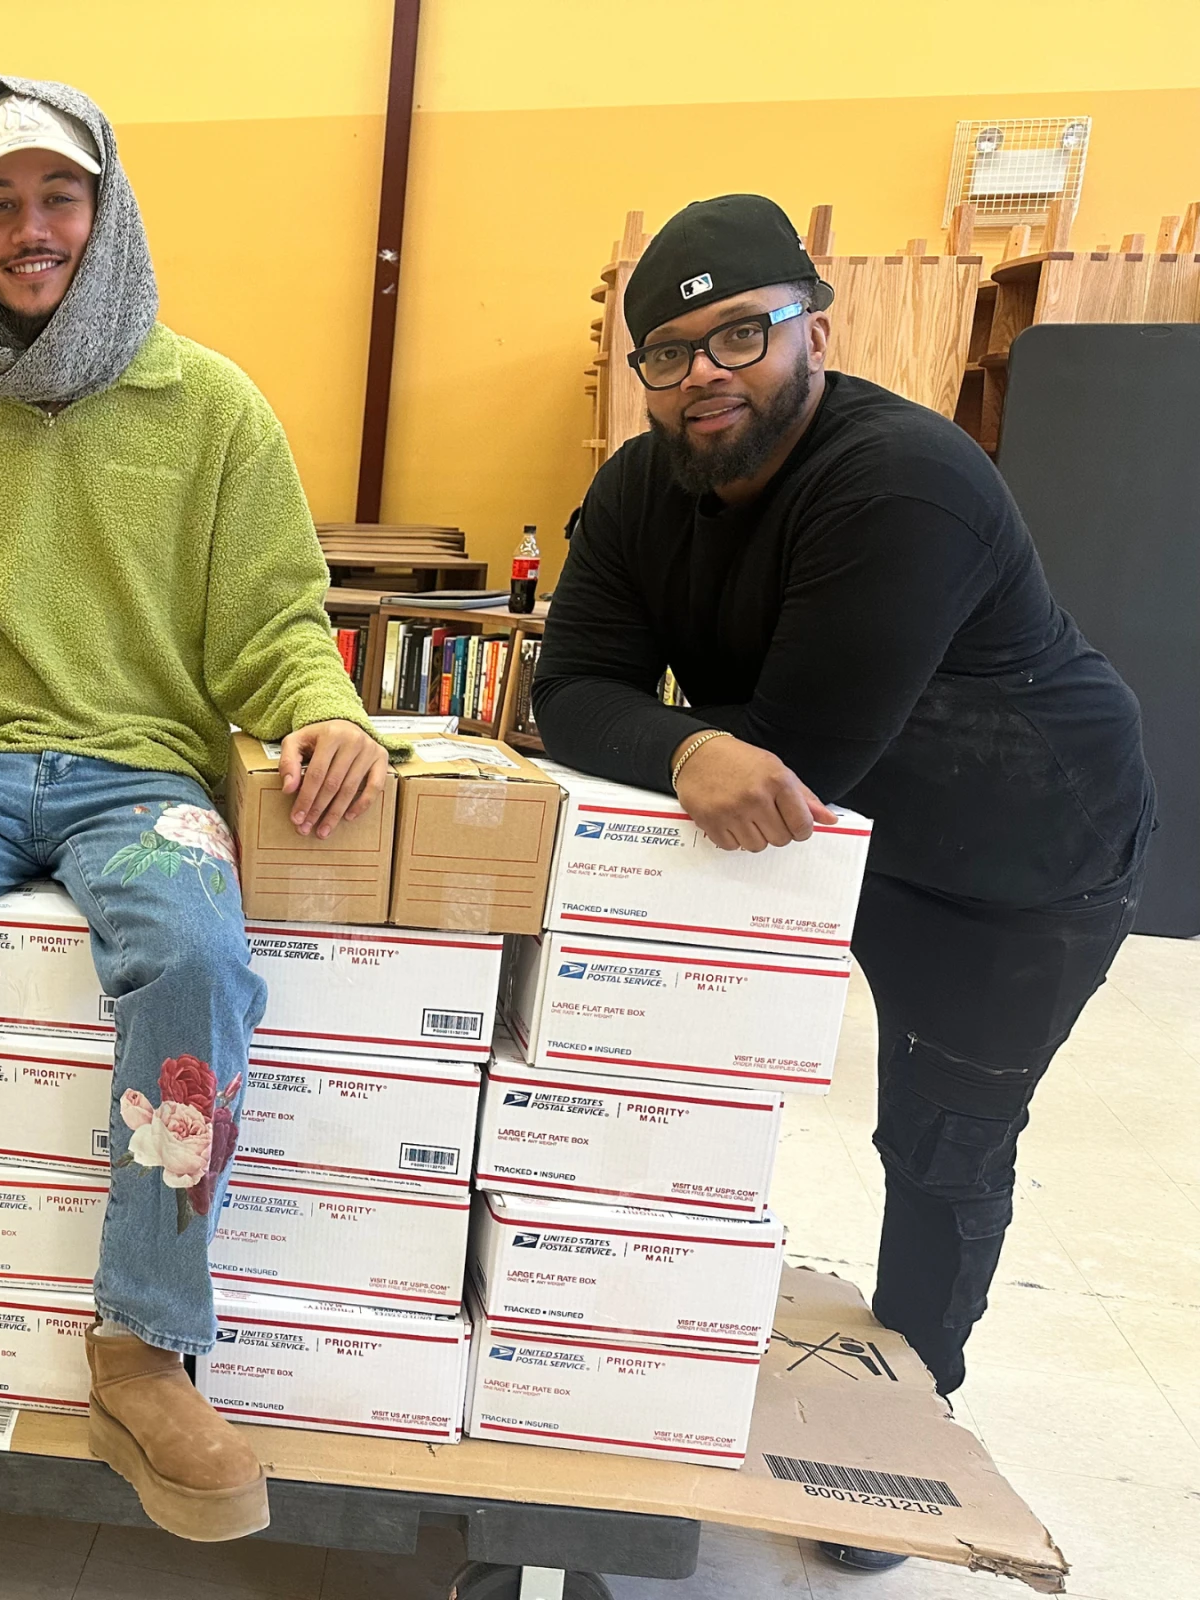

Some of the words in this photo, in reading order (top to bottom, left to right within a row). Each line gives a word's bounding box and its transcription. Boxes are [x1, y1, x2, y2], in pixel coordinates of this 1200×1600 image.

[608, 822, 645, 833] UNITED
[645, 826, 680, 836] STATES
[604, 832, 640, 843] POSTAL
[568, 861, 597, 871] LARGE
[598, 864, 618, 873] FLAT
[620, 867, 642, 875] RATE
[643, 869, 663, 877] BOX
[561, 902, 602, 913] TRACKED
[610, 907, 648, 918] INSURED
[253, 938, 287, 948] UNITED
[287, 941, 319, 951] STATES
[249, 948, 282, 957] POSTAL
[352, 957, 380, 965] MAIL
[590, 964, 627, 974] UNITED
[627, 967, 661, 977] STATES
[586, 973, 622, 983] POSTAL
[697, 983, 728, 992] MAIL
[552, 1001, 580, 1011] LARGE
[582, 1004, 602, 1013] FLAT
[603, 1006, 625, 1015] RATE
[626, 1009, 646, 1017] BOX
[547, 1040, 587, 1051] TRACKED
[594, 1045, 632, 1056] INSURED
[34, 1078, 60, 1087] MAIL
[341, 1090, 368, 1099] MAIL
[534, 1093, 571, 1103] UNITED
[571, 1097, 604, 1107] STATES
[531, 1102, 566, 1112] POSTAL
[639, 1114, 669, 1124] MAIL
[250, 1147, 286, 1157] INSURED
[235, 1194, 267, 1203] UNITED
[268, 1197, 298, 1206] STATES
[232, 1202, 263, 1212] POSTAL
[331, 1213, 358, 1221] MAIL
[543, 1234, 578, 1244] UNITED
[578, 1238, 611, 1247] STATES
[539, 1243, 573, 1253] POSTAL
[645, 1254, 674, 1262] MAIL
[504, 1305, 542, 1315] TRACKED
[549, 1310, 584, 1320] INSURED
[241, 1329, 273, 1339] UNITED
[274, 1333, 304, 1342] STATES
[238, 1338, 269, 1347] POSTAL
[337, 1348, 364, 1356] MAIL
[519, 1348, 553, 1357] UNITED
[553, 1352, 585, 1361] STATES
[515, 1356, 548, 1366] POSTAL
[210, 1362, 235, 1371] LARGE
[618, 1367, 646, 1376] MAIL
[484, 1380, 510, 1389] LARGE
[532, 1386, 552, 1394] RATE
[804, 1485, 943, 1516] 8001231218
